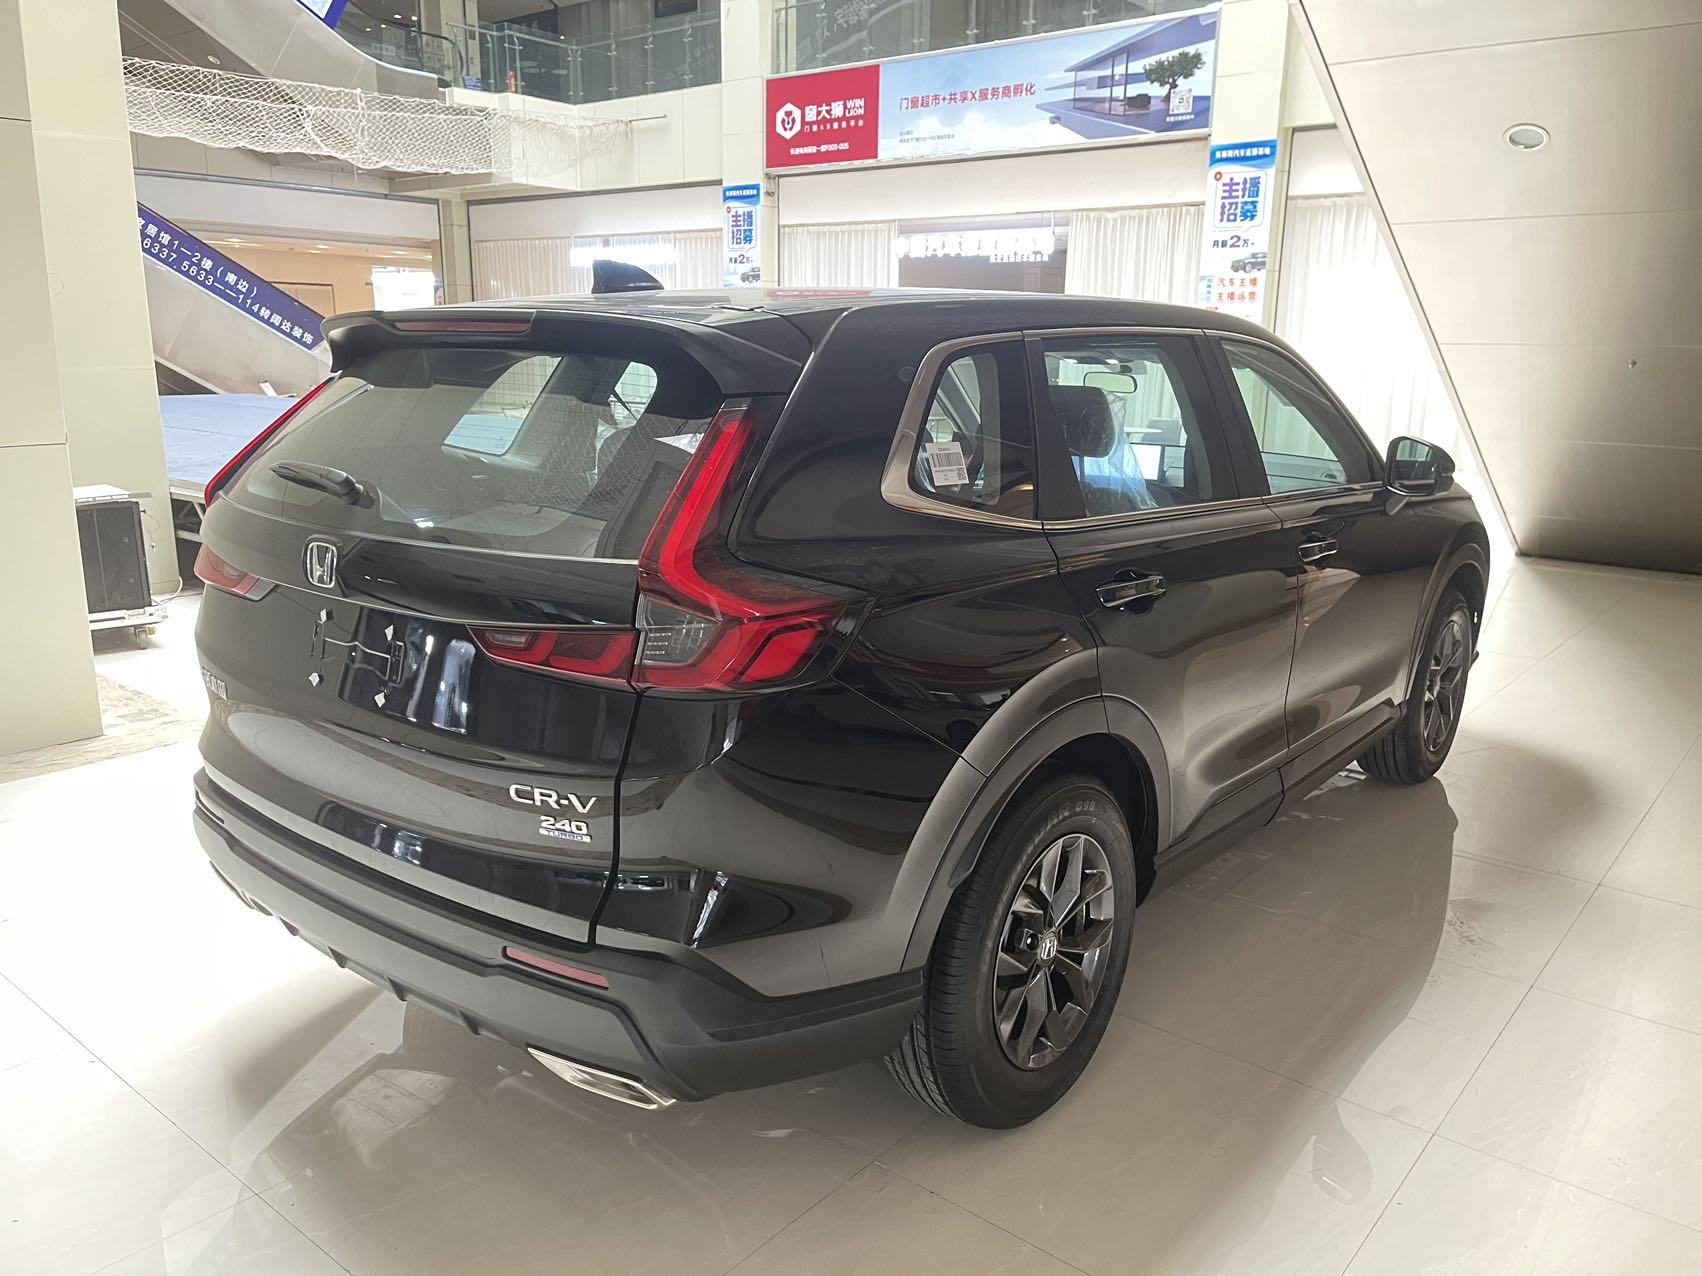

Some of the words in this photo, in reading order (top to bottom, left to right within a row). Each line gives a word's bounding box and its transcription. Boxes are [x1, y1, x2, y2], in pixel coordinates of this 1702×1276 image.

[846, 98, 864, 108] WIN
[899, 82, 1036, 110] 门窗超市+共享X服务商孵化
[846, 107, 864, 117] LION
[1221, 176, 1261, 200] 主播
[731, 210, 753, 228] 主播
[1220, 201, 1259, 223] 招募
[731, 228, 753, 245] 招募
[1217, 277, 1258, 287] 汽车主播
[509, 784, 598, 814] CR-V
[540, 815, 588, 835] 240
[543, 829, 584, 841] TURBO
